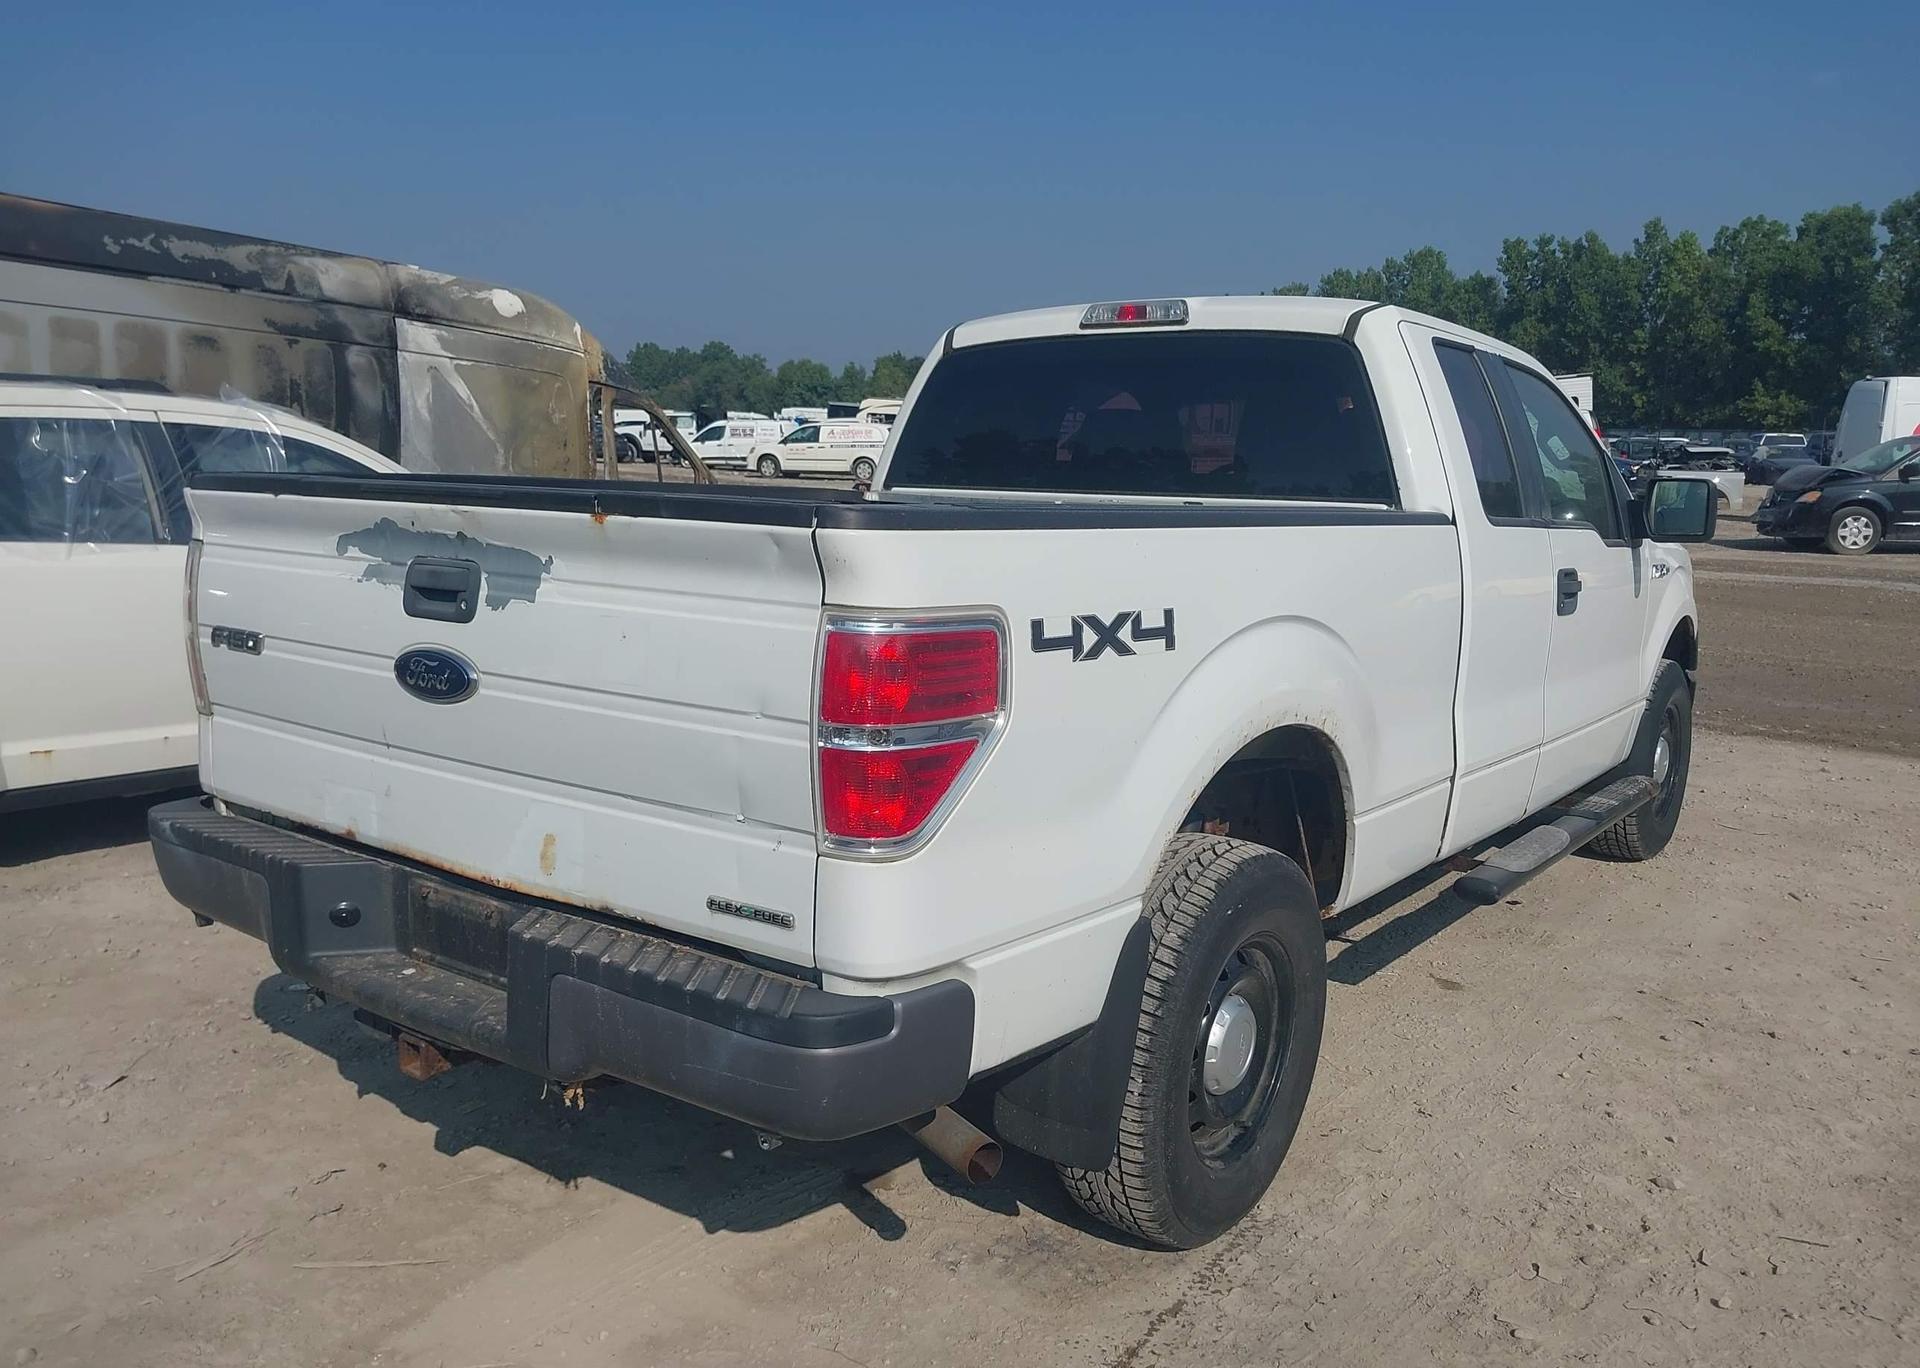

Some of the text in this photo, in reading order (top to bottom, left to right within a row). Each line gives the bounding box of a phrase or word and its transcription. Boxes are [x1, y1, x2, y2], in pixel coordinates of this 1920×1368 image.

[406, 656, 451, 690] Ford
[708, 899, 792, 926] FLEX FUEL
